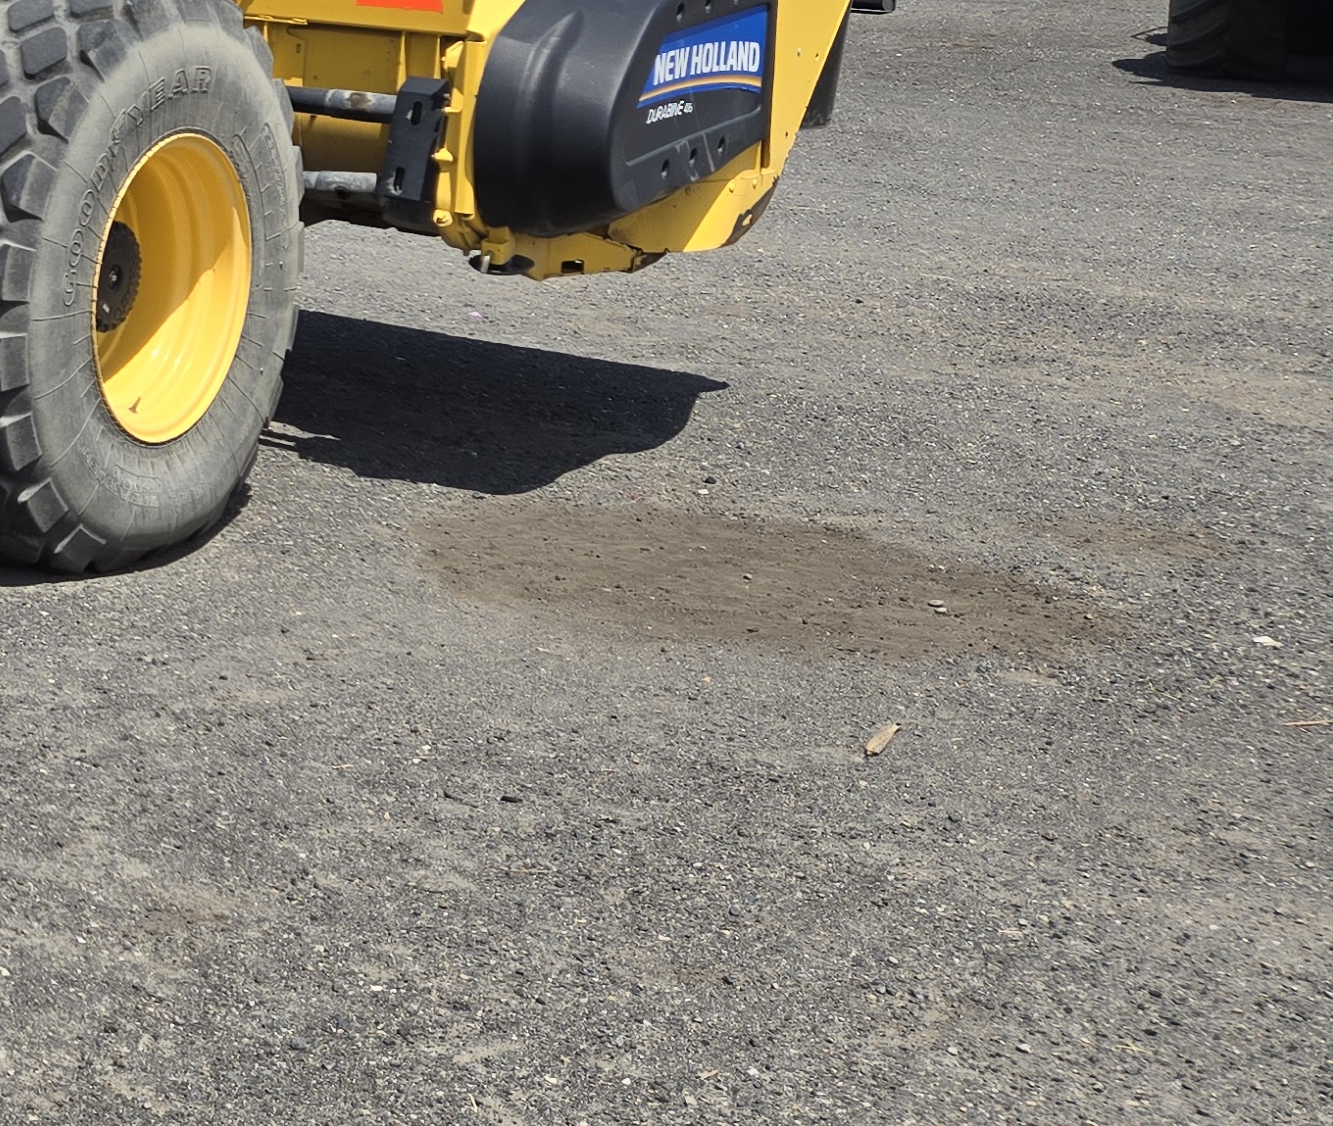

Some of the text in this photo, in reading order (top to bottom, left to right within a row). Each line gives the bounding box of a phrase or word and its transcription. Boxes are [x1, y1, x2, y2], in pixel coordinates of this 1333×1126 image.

[653, 40, 761, 86] NEW HOLLAND
[63, 65, 213, 308] GOODYEAR
